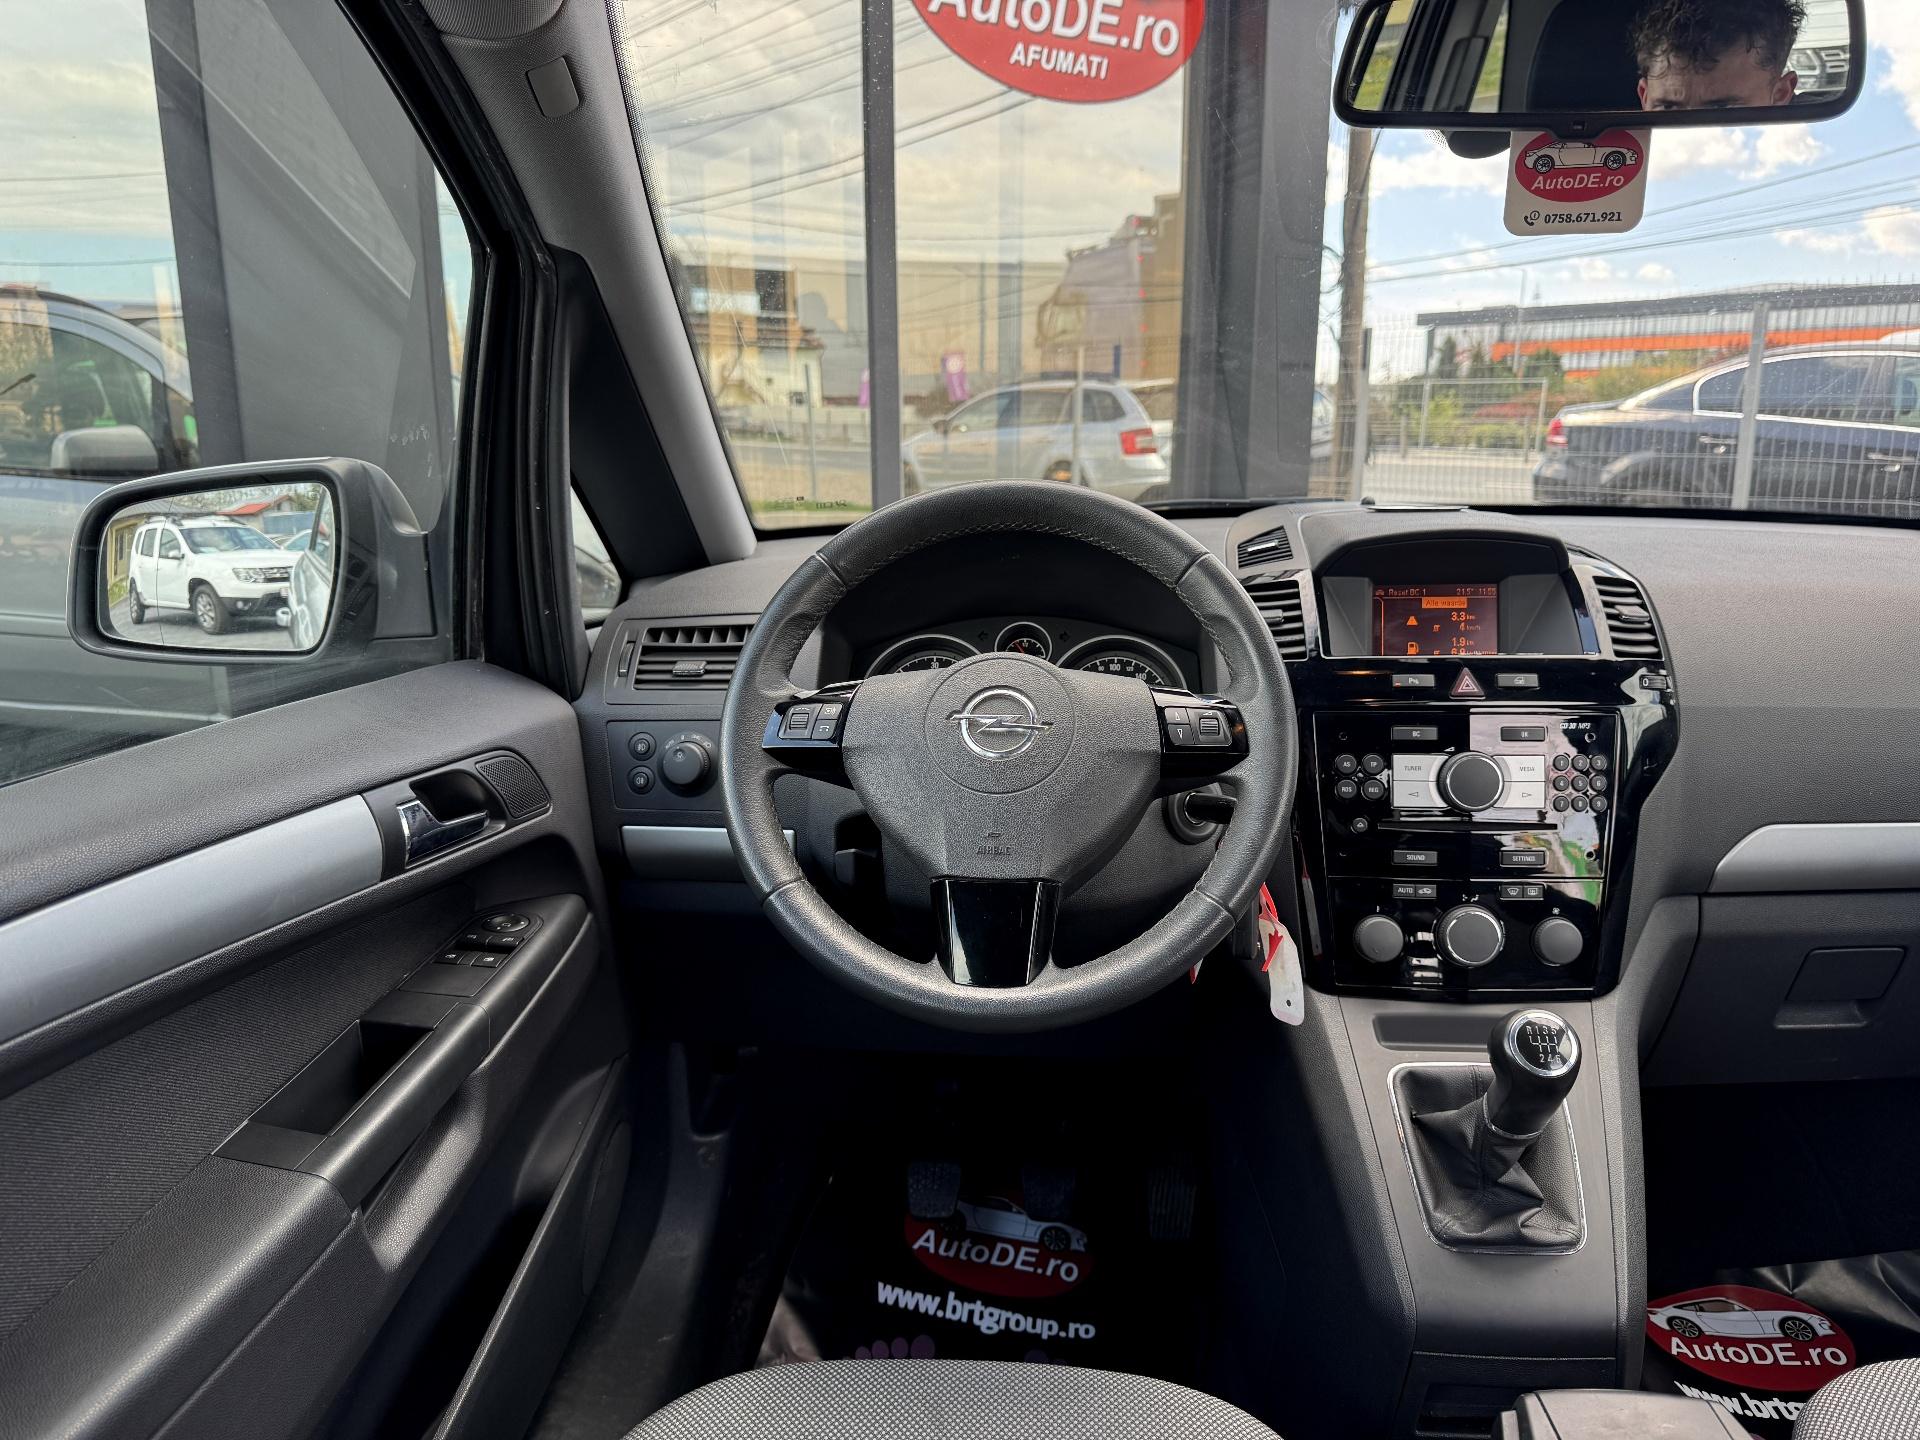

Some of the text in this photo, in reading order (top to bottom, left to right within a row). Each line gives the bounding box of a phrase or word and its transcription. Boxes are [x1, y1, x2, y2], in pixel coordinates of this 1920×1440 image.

[1009, 42, 1108, 80] AFUMATI
[1531, 173, 1625, 191] AutoDE.ro
[1544, 211, 1622, 224] 0758.671.921
[1451, 612, 1466, 621] 3.3
[1109, 663, 1120, 671] 100
[1412, 730, 1420, 738] BC
[912, 1228, 1080, 1283] AutoDE.ro
[877, 1281, 1097, 1340] www.brtgroup.ro
[1670, 1336, 1848, 1366] AutoDE.ro
